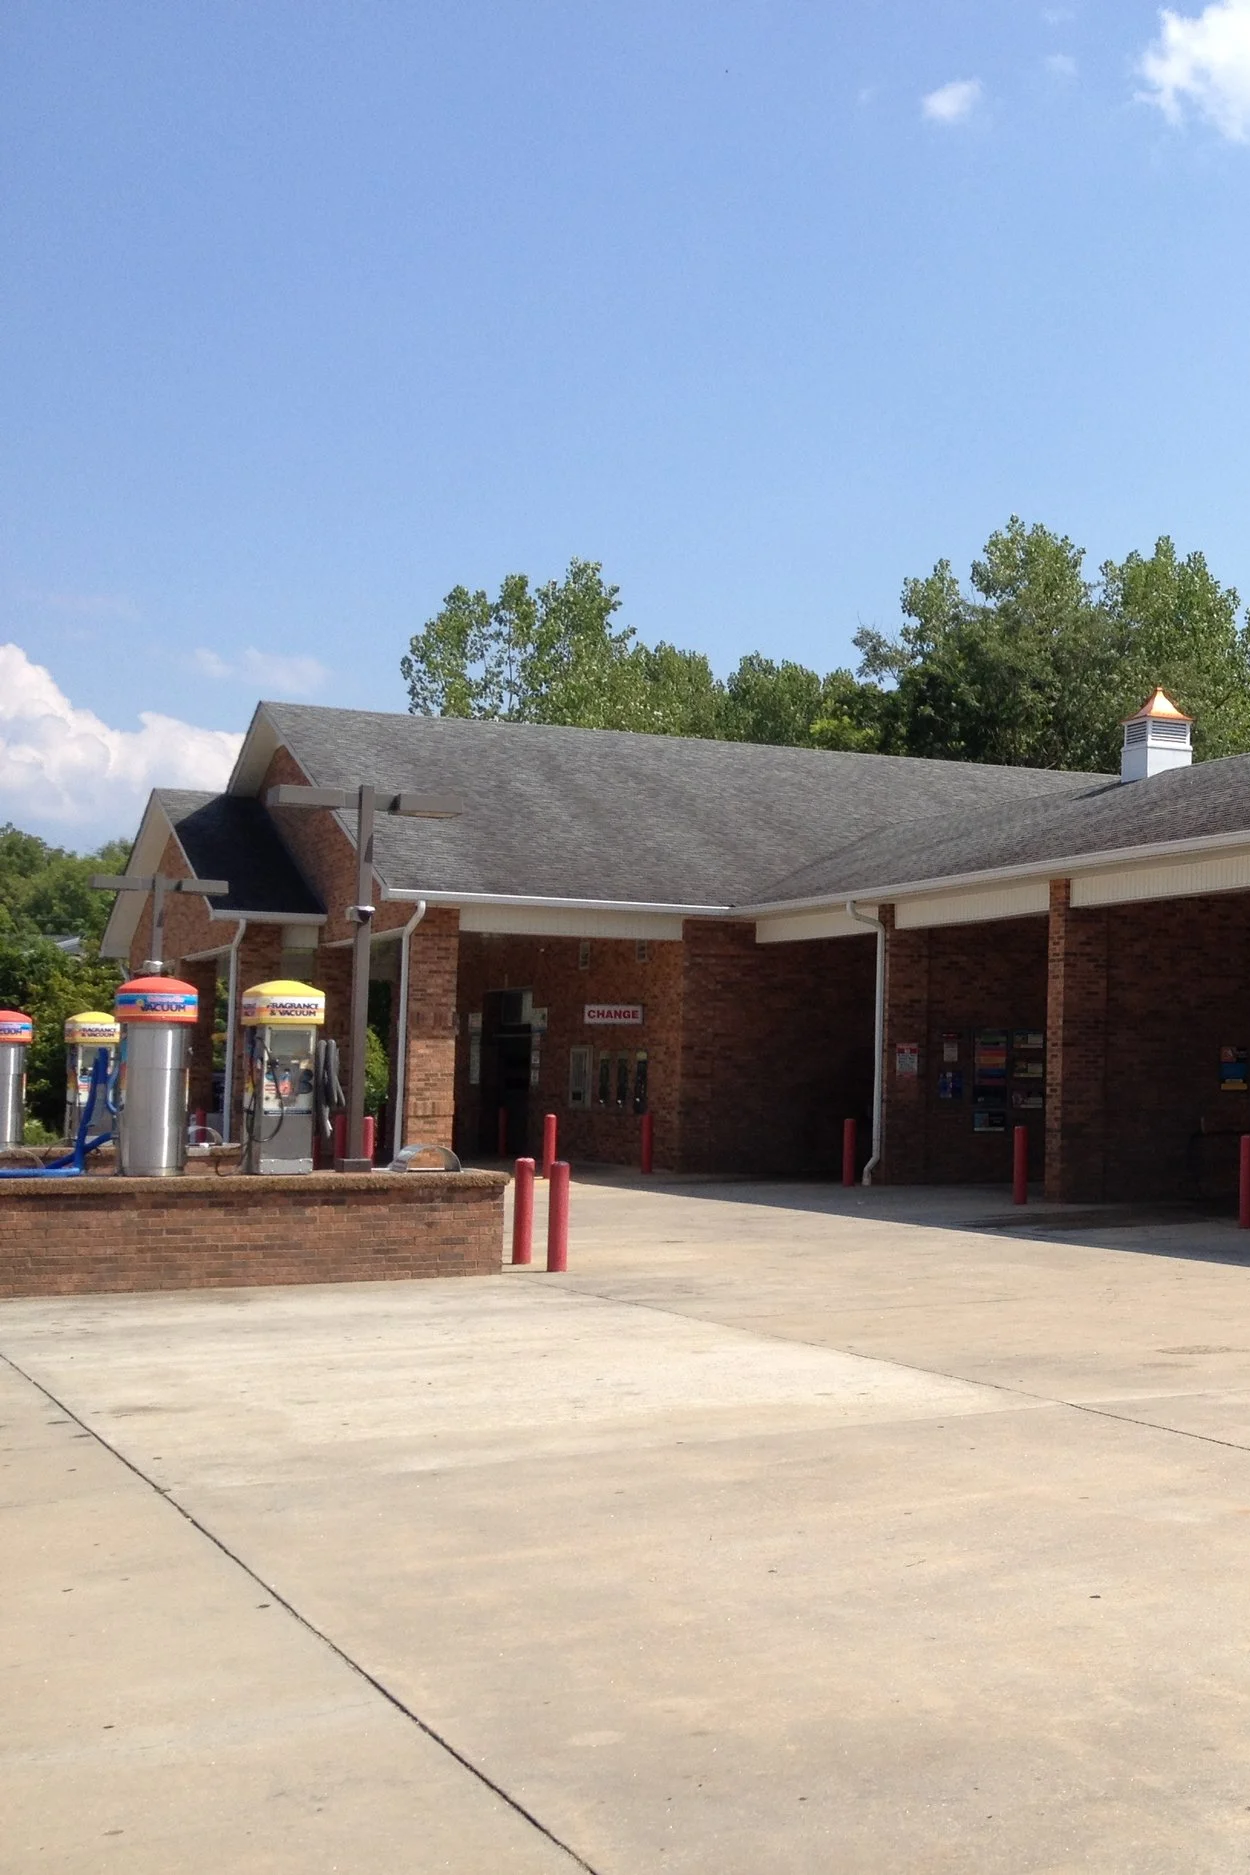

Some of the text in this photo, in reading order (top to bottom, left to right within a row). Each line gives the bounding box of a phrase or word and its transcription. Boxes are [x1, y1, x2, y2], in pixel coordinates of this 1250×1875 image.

[140, 1002, 186, 1012] VACUUM
[267, 1002, 319, 1010] FRAGRANCE
[587, 1009, 640, 1019] CHANGE
